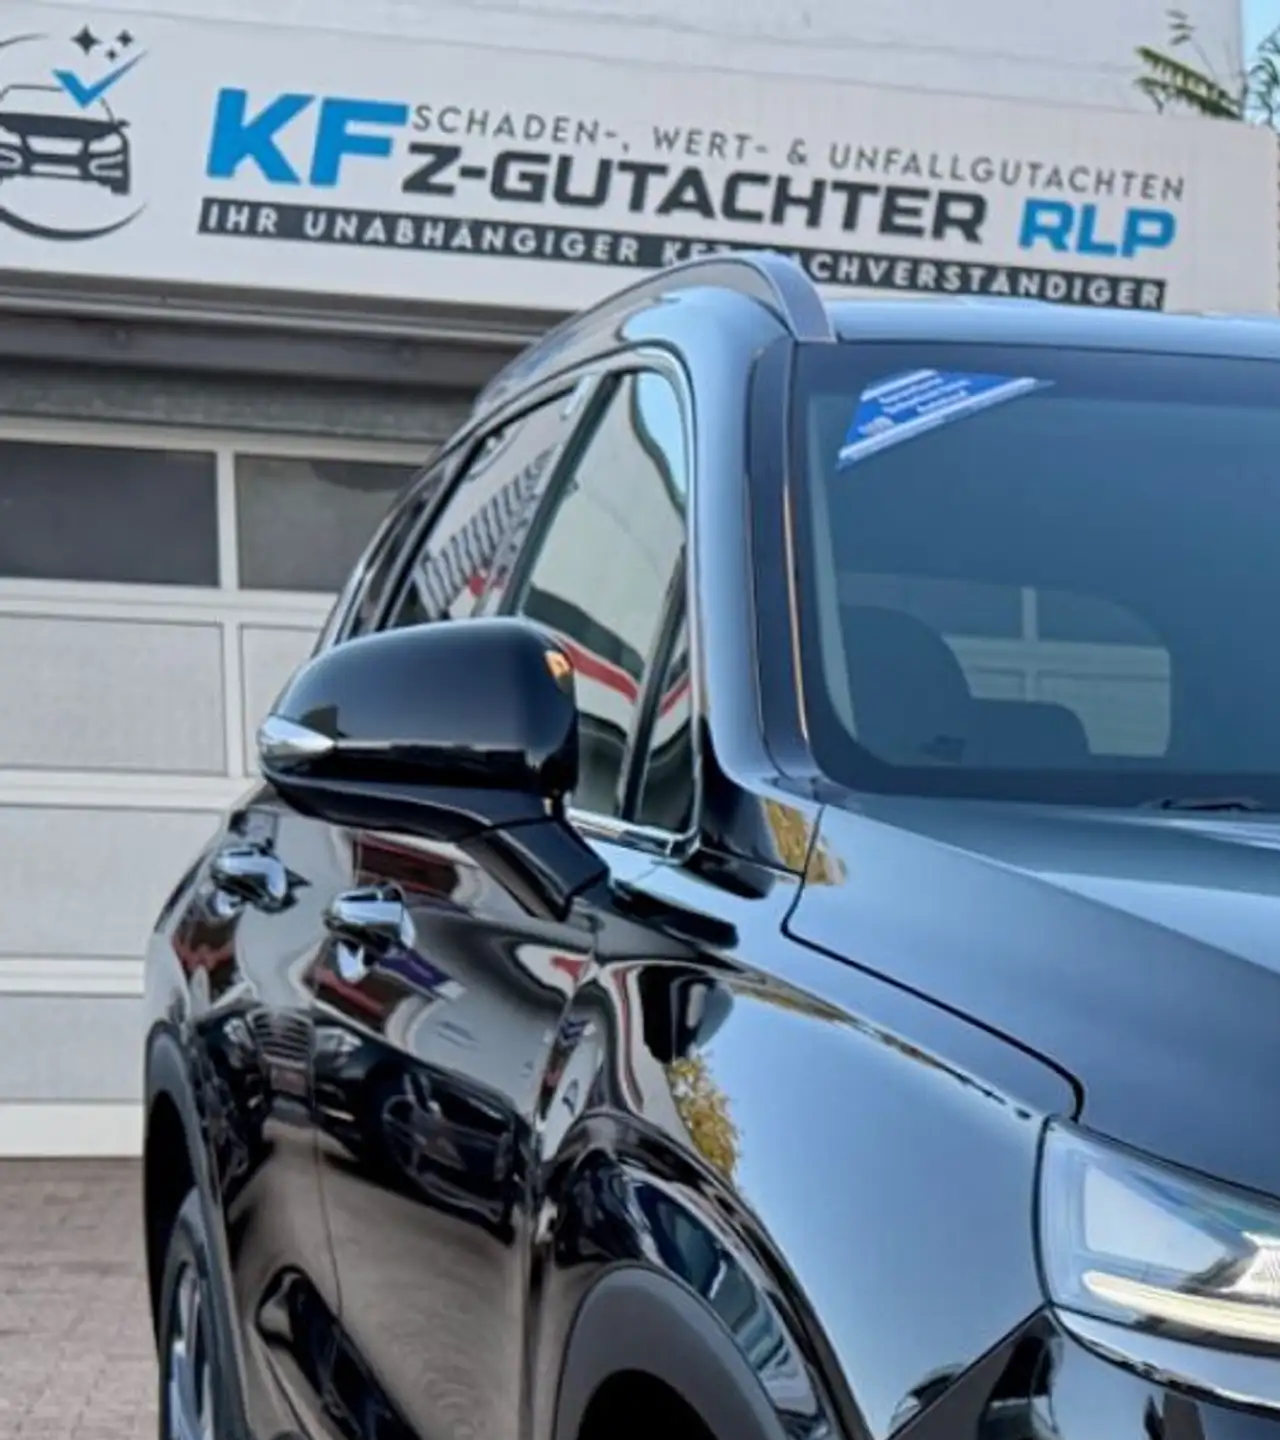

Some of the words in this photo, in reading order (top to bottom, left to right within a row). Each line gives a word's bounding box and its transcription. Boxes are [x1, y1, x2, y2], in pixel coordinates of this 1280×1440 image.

[412, 103, 630, 154] SCHADEN-,
[652, 126, 767, 159] WERT-
[787, 138, 808, 166] &
[829, 142, 1185, 200] UNFALLGUTACHTEN
[209, 202, 280, 234] IHR
[305, 209, 639, 264] UNABHÄNGIGER
[1018, 199, 1176, 258] RLP
